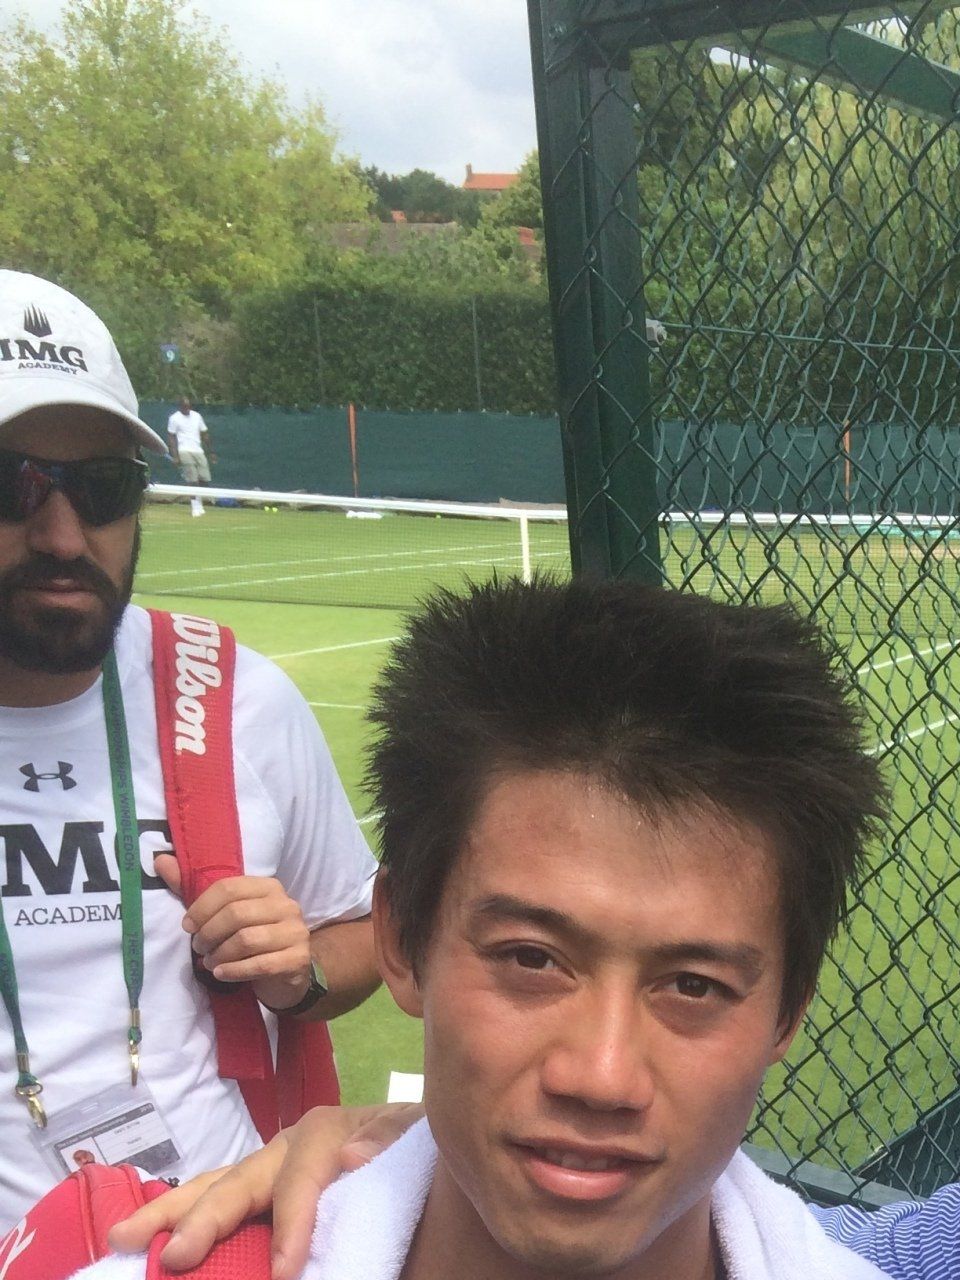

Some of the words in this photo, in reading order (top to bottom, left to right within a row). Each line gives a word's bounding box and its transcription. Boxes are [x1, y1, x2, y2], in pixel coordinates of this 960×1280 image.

[0, 338, 89, 373] IMG
[17, 362, 79, 376] ACADEMY
[170, 612, 223, 757] Wilson
[120, 793, 134, 872] WIMBLEDON
[14, 903, 123, 927] ACADEM
